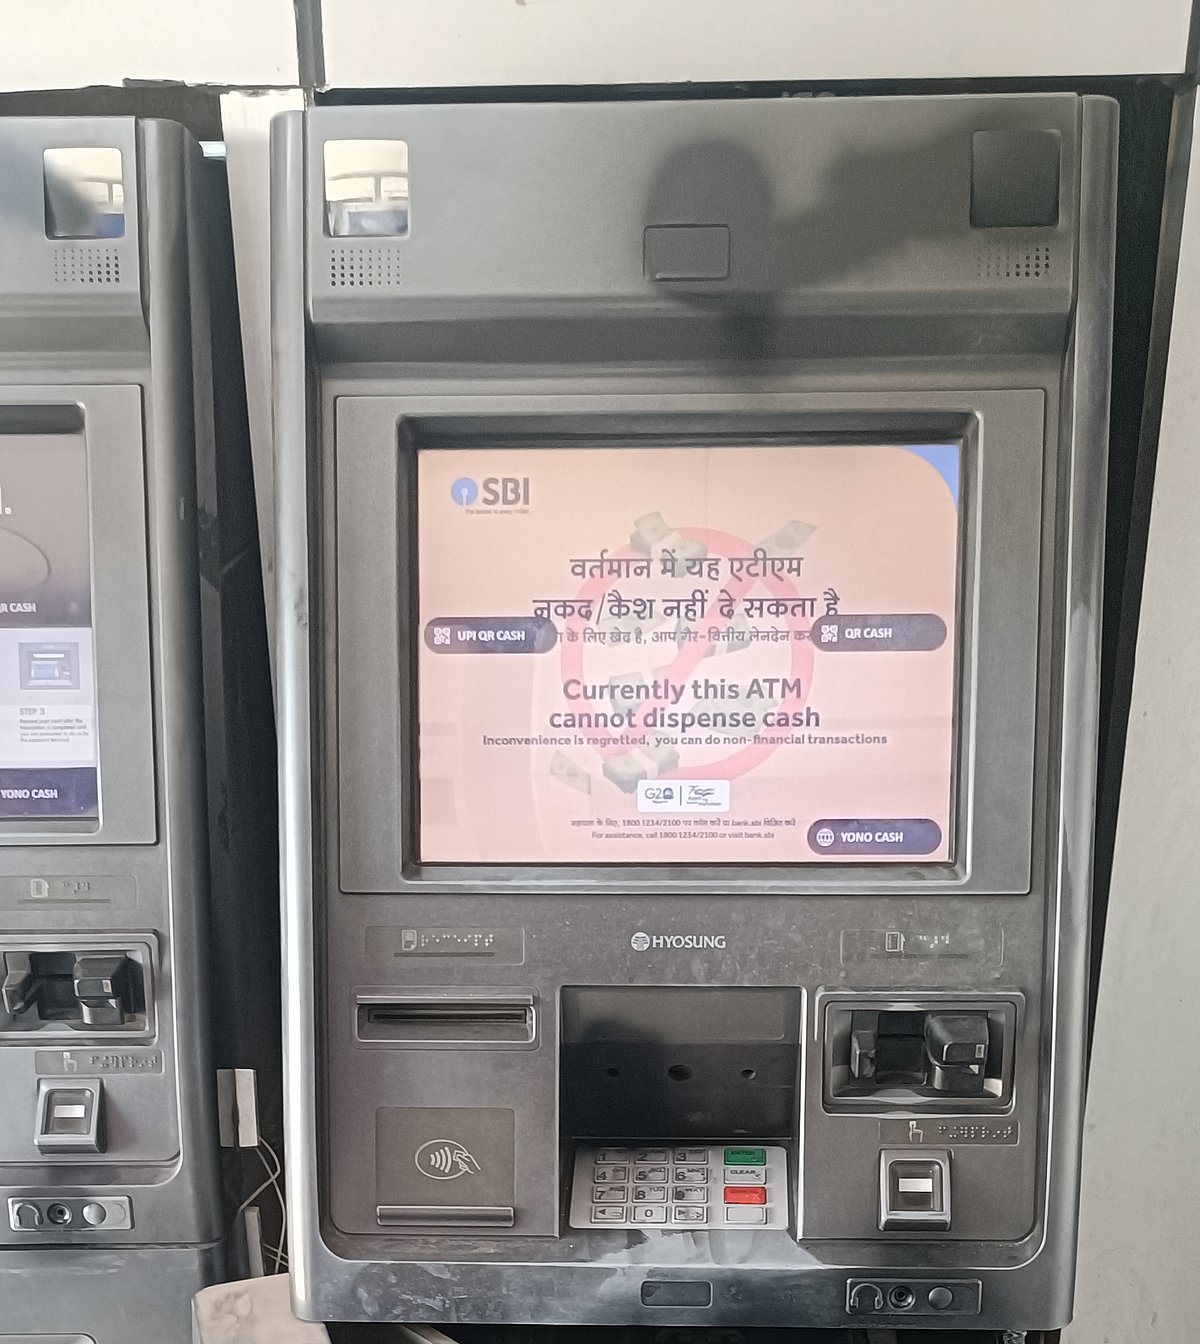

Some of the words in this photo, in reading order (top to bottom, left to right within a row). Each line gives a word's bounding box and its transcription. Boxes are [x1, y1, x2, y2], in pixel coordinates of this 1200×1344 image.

[482, 477, 530, 505] SBI
[569, 549, 653, 579] वर्तमान
[660, 548, 678, 578] में
[685, 557, 721, 580] यह
[728, 547, 804, 582] एटीएम
[9, 602, 37, 613] CASH
[662, 589, 709, 622] नहीं
[718, 588, 736, 619] दे
[743, 597, 818, 618] सकता
[457, 630, 476, 641] UPI
[478, 630, 496, 641] QR
[496, 630, 526, 641] CASH
[566, 627, 579, 642] के
[582, 627, 607, 645] लिए
[609, 627, 631, 643] खेद
[651, 631, 678, 643] आप
[749, 626, 791, 643] लेनदेन
[844, 628, 862, 640] QR
[863, 628, 893, 639] CASH
[563, 679, 686, 705] Currently
[691, 678, 740, 700] this
[745, 678, 802, 699] ATM
[549, 709, 637, 728] cannot
[643, 707, 756, 733] dispense
[762, 706, 820, 728] cash
[482, 735, 571, 746] Inconvenience
[574, 735, 584, 745] is
[587, 735, 650, 748] regretted,
[654, 737, 678, 748] you
[681, 737, 702, 745] can
[704, 735, 720, 745] do
[808, 734, 888, 745] transactions
[0, 789, 31, 799] YONO
[31, 789, 58, 799] CASH
[841, 832, 873, 843] YONO
[874, 832, 904, 843] CASH
[652, 935, 726, 949] HYOSUNG
[676, 1152, 687, 1161] 3
[597, 1171, 607, 1180] 4
[638, 1171, 647, 1180] 5
[676, 1171, 686, 1181] 6
[596, 1191, 606, 1199] 7
